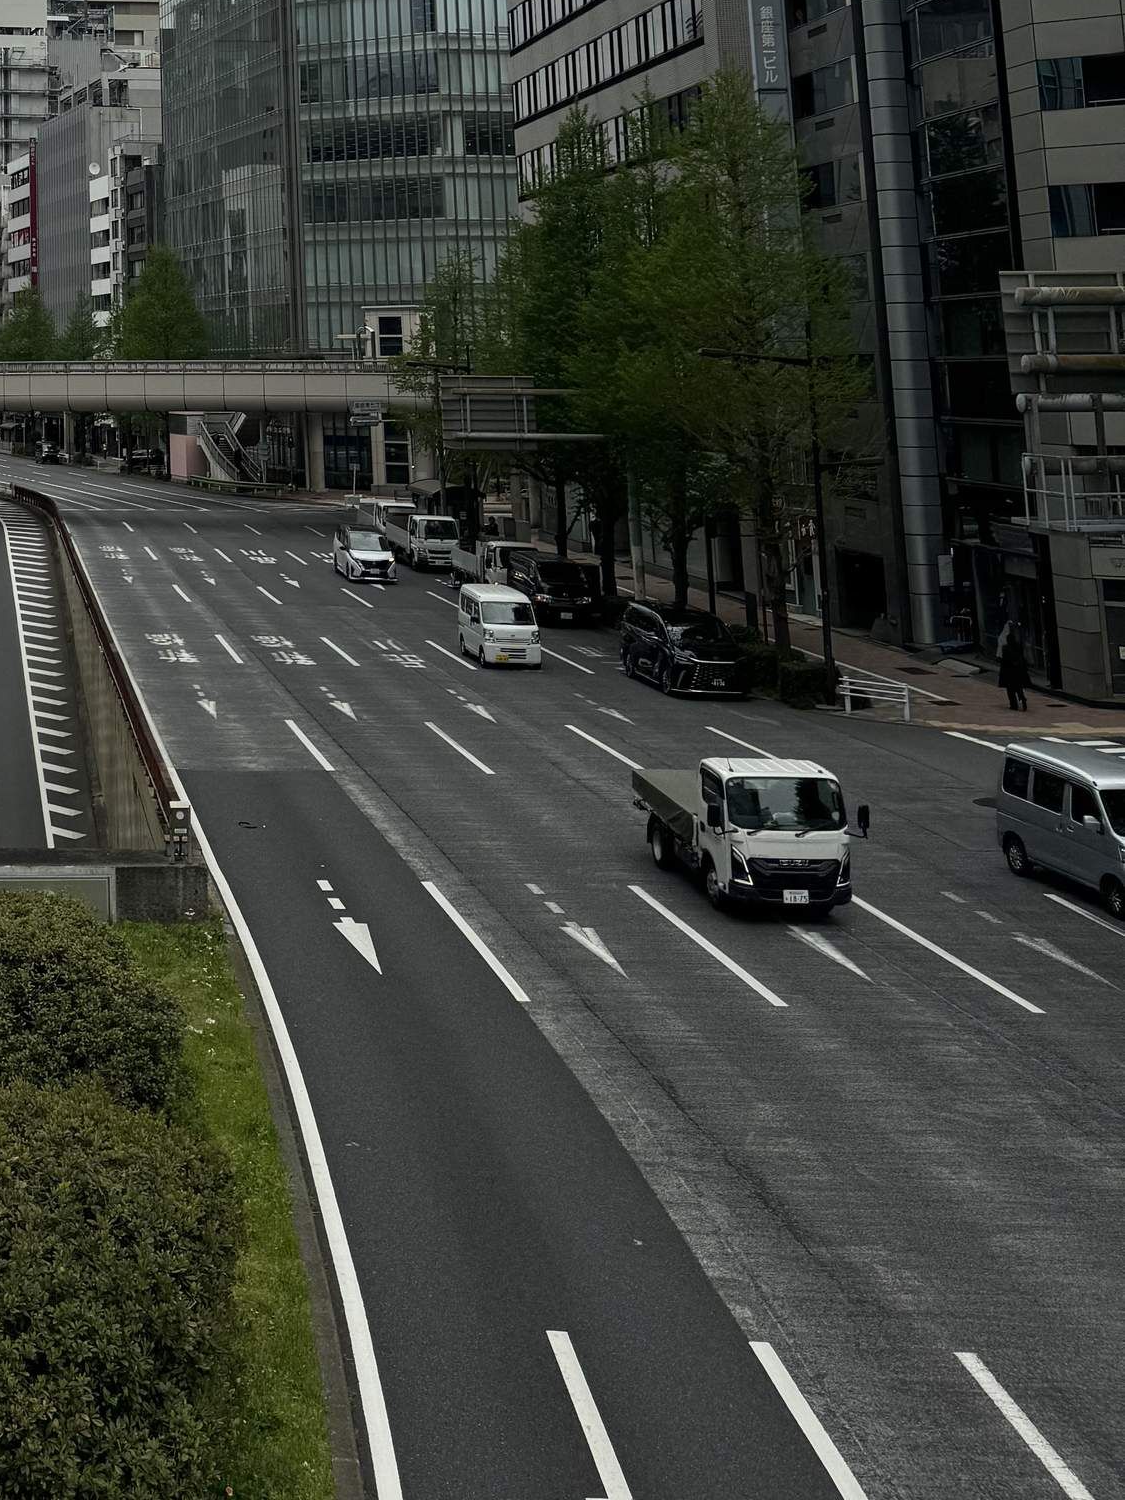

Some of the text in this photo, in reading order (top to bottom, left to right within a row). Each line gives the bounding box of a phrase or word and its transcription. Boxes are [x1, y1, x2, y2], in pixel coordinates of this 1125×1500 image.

[759, 5, 779, 83] 銀座第一ビル
